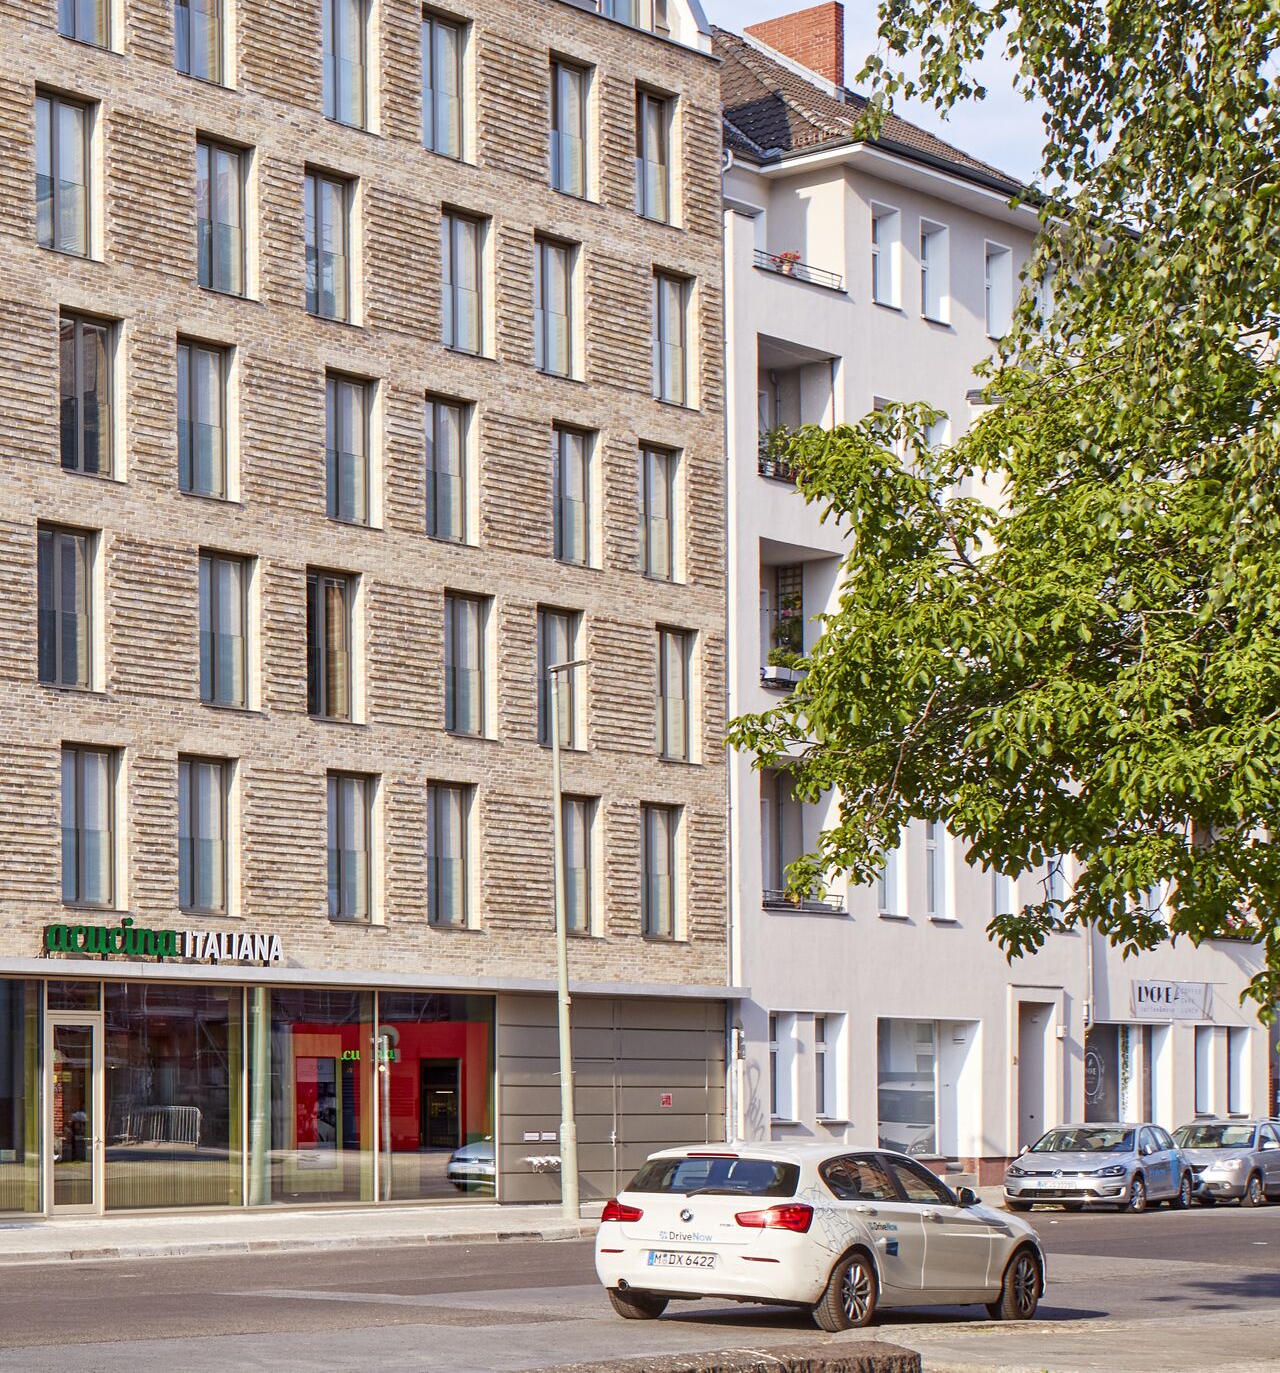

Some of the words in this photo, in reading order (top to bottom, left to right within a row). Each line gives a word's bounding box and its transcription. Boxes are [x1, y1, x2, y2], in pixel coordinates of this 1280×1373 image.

[44, 917, 178, 957] acucina
[183, 930, 284, 962] ITALIANA
[1138, 986, 1173, 1004] LYCKE
[669, 1231, 713, 1241] DriveNow
[668, 1254, 683, 1265] DX
[685, 1255, 715, 1267] 6422
